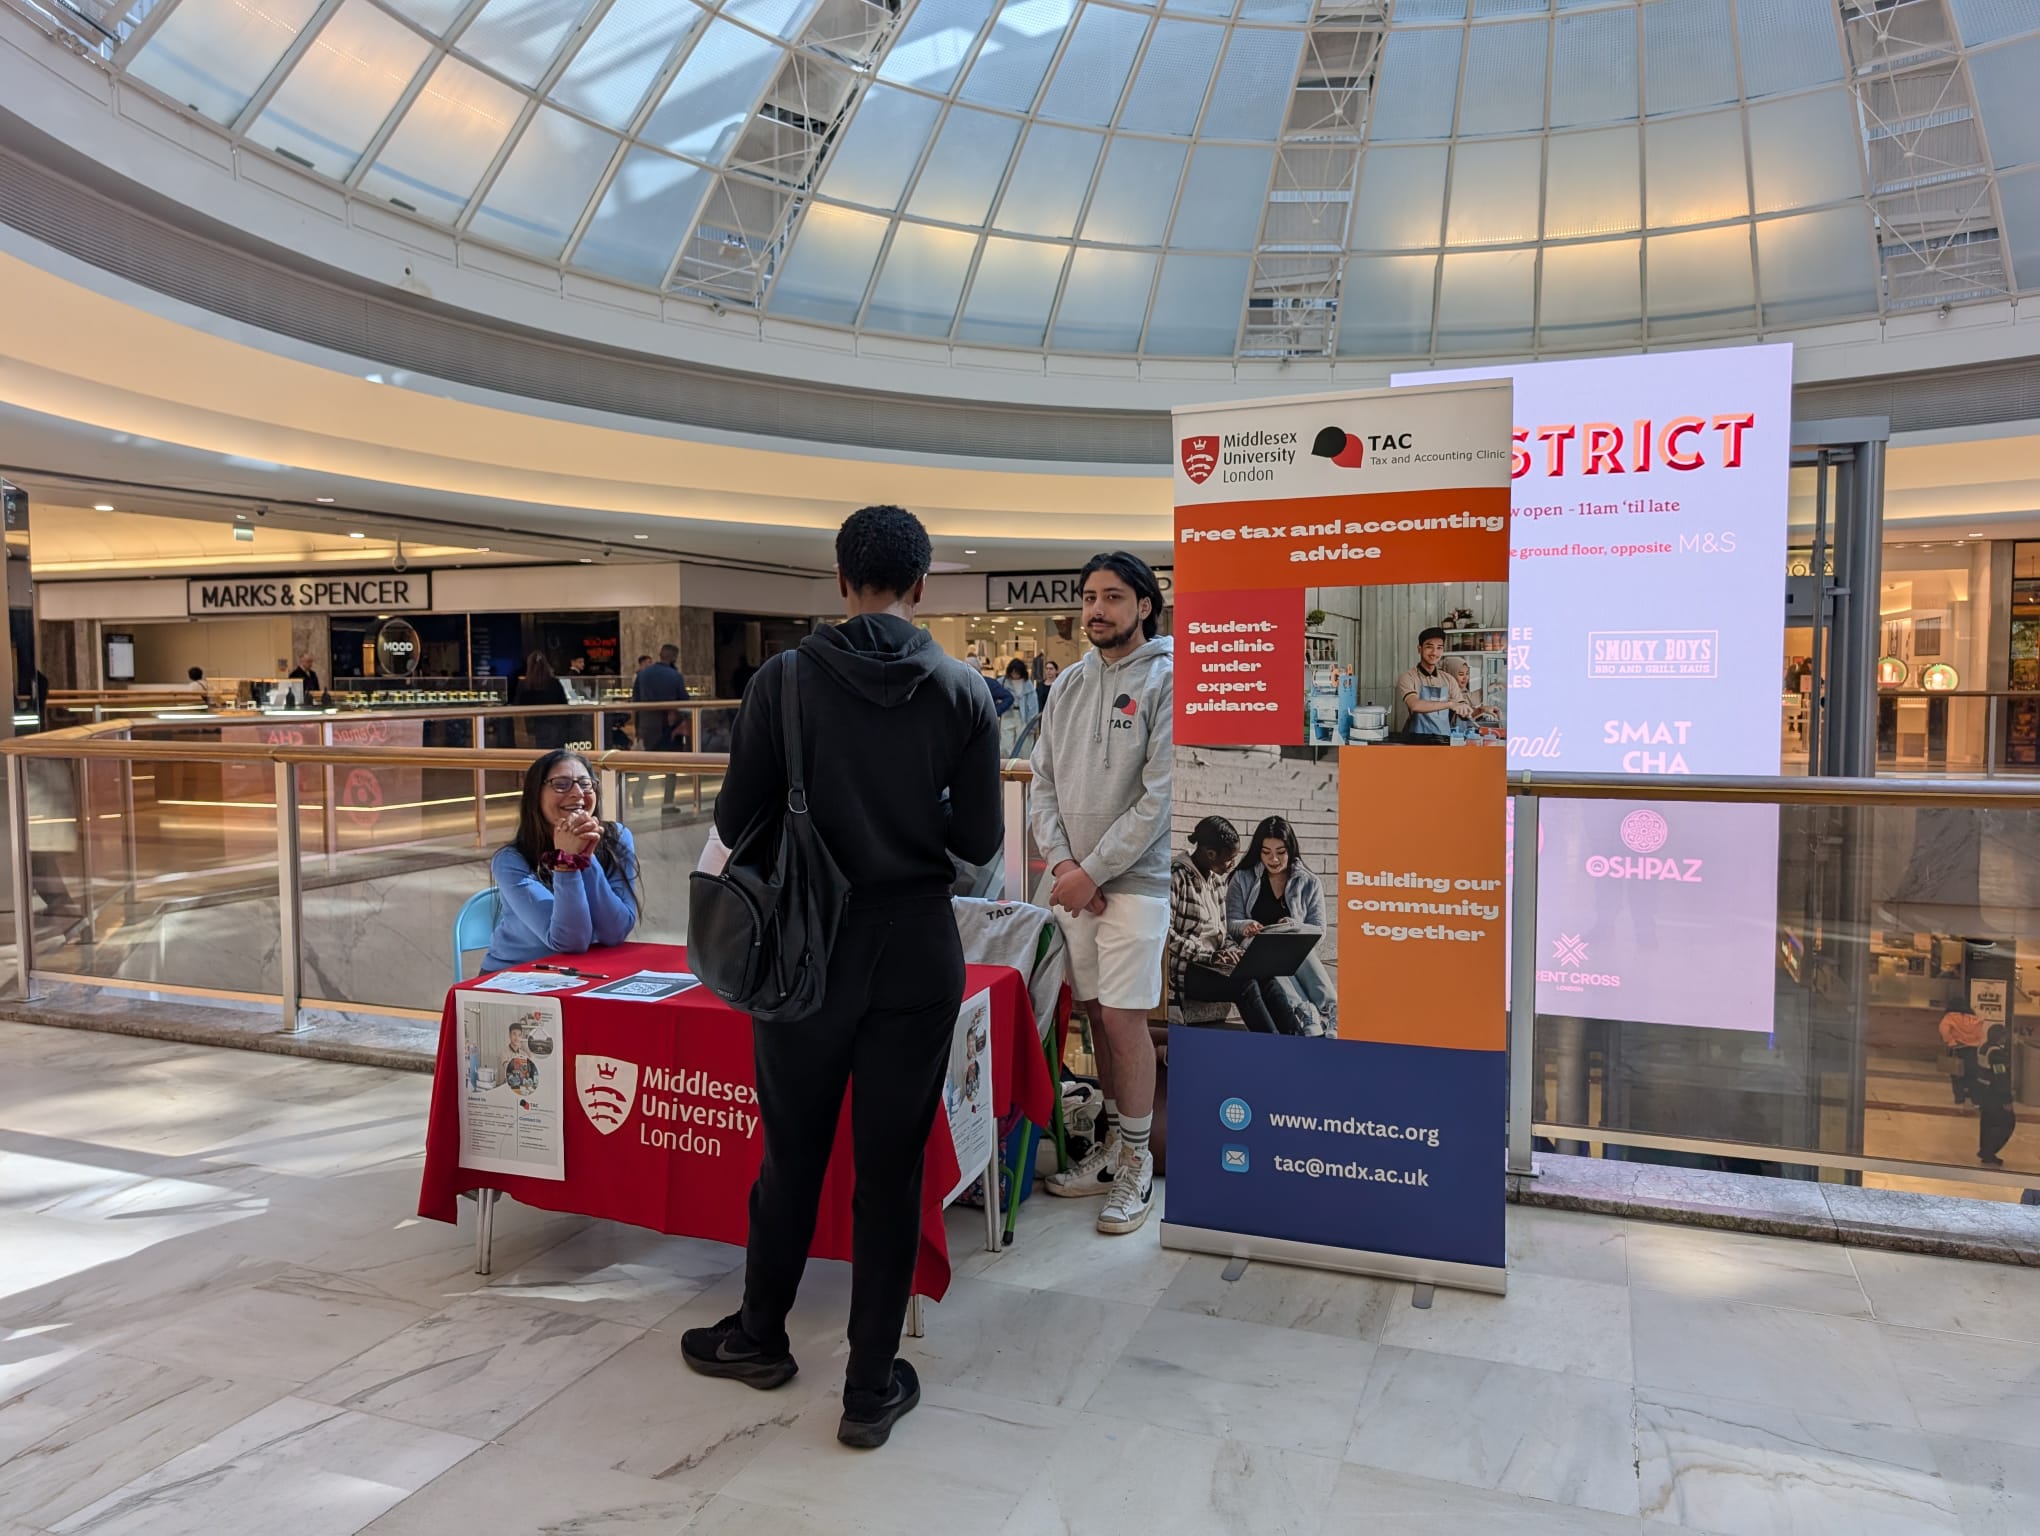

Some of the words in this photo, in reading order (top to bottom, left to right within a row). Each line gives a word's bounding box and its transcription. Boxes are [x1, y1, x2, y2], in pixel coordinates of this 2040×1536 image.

[1223, 431, 1297, 448] Middlesex
[1365, 433, 1413, 451] TAC
[1223, 448, 1296, 465] University
[1370, 457, 1388, 465] Tax
[1391, 454, 1411, 464] and
[1414, 451, 1473, 462] Accounting
[1476, 450, 1506, 460] Clinic
[1223, 466, 1274, 483] London
[1523, 505, 1563, 520] open
[1578, 502, 1618, 515] 11am
[1649, 499, 1681, 512] late
[1180, 528, 1236, 543] Free
[1239, 524, 1287, 540] tax
[1289, 519, 1342, 538] and
[1344, 511, 1505, 536] accounting
[1289, 543, 1382, 562] advice
[1519, 543, 1569, 560] ground
[1571, 543, 1608, 557] floor,
[1610, 541, 1673, 557] opposite
[1679, 531, 1737, 553] M&S
[202, 583, 277, 608] MARKS
[280, 584, 295, 606] &
[299, 580, 410, 605] SPENCER
[1188, 620, 1278, 634] Student-
[383, 642, 414, 652] MOOD
[1190, 640, 1219, 654] led
[1221, 639, 1275, 653] clinic
[1595, 639, 1659, 661] SMOKY
[1665, 639, 1711, 661] BOYS
[1202, 660, 1262, 672] under
[1619, 664, 1642, 673] AND
[1196, 680, 1267, 694] expert
[1185, 699, 1279, 714] guidance
[1107, 719, 1133, 729] TAC
[1603, 720, 1692, 744] SMAT
[564, 741, 592, 751] MOOD
[1622, 751, 1690, 774] CHA
[1346, 871, 1450, 893] Building
[1454, 879, 1502, 891] our
[985, 906, 1013, 920] TAC
[1347, 899, 1499, 920] community
[1361, 922, 1486, 941] together
[1570, 972, 1621, 987] CROSS
[642, 1066, 759, 1105] Middlesex
[642, 1094, 758, 1139] University
[1269, 1113, 1440, 1147] www.mdxtac.org
[641, 1122, 721, 1157] London
[1273, 1155, 1429, 1187] tac@mdx.ac.uk
